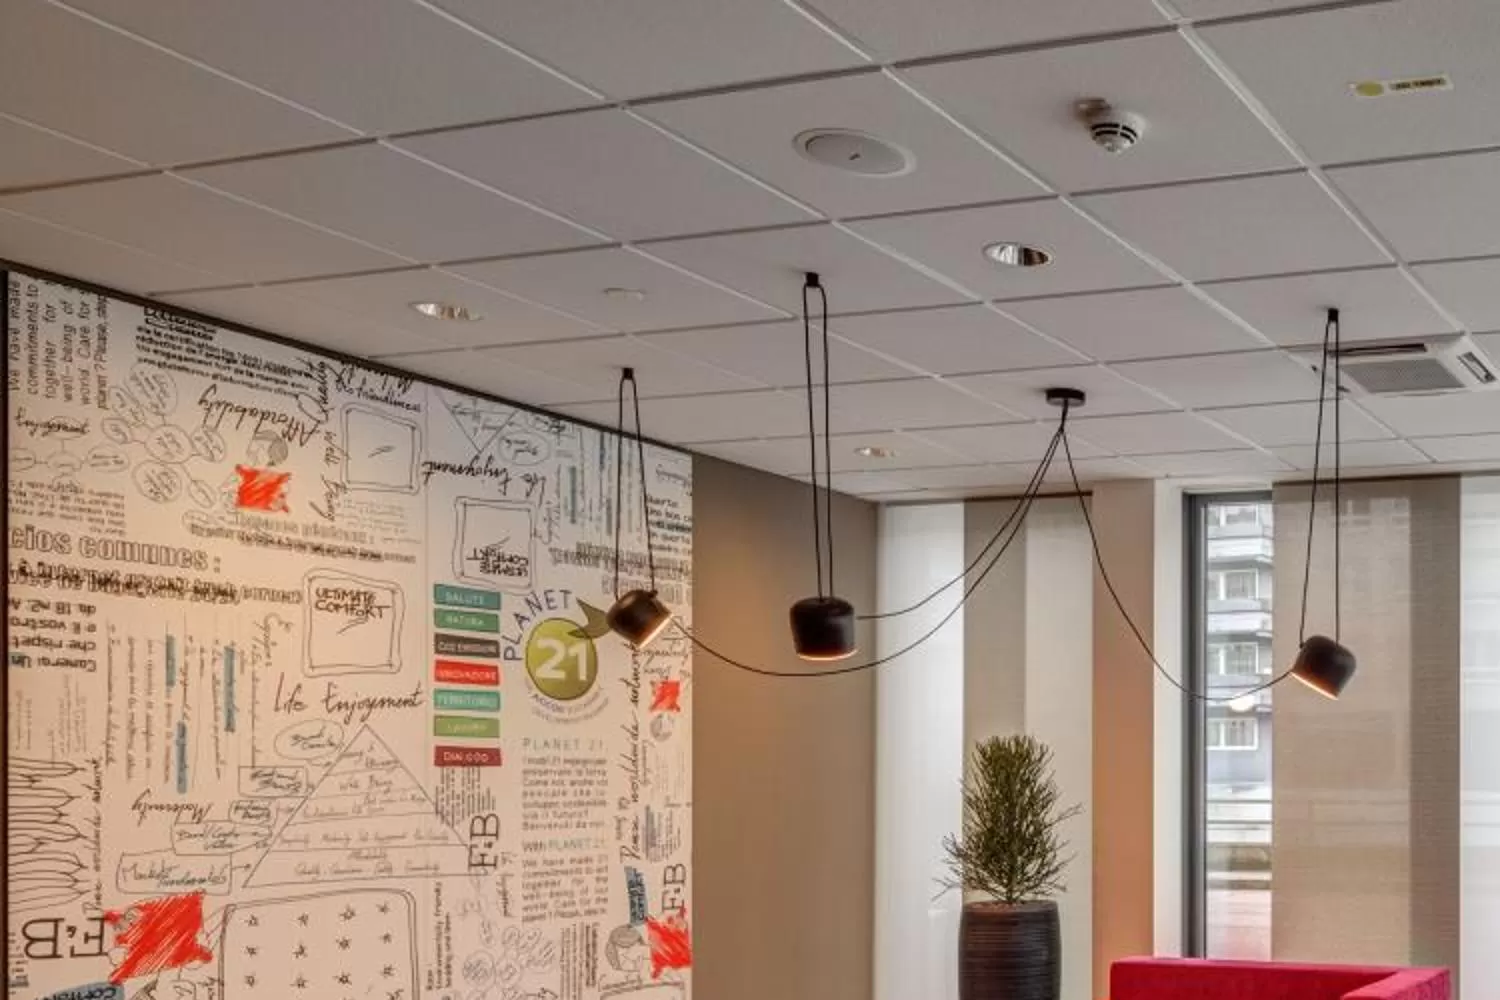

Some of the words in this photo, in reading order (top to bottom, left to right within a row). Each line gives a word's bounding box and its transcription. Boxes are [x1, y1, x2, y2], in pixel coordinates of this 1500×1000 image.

[42, 304, 57, 323] for
[26, 302, 38, 395] commitments
[78, 327, 90, 358] Care
[44, 340, 59, 399] together
[198, 384, 321, 447] Affordability
[315, 600, 392, 619] COMFORT
[444, 591, 485, 605] SALUTE
[503, 589, 573, 661] PLANET
[535, 638, 589, 683] 21
[274, 672, 308, 713] Life
[522, 738, 579, 752] PLANET
[21, 917, 109, 960] F&B
